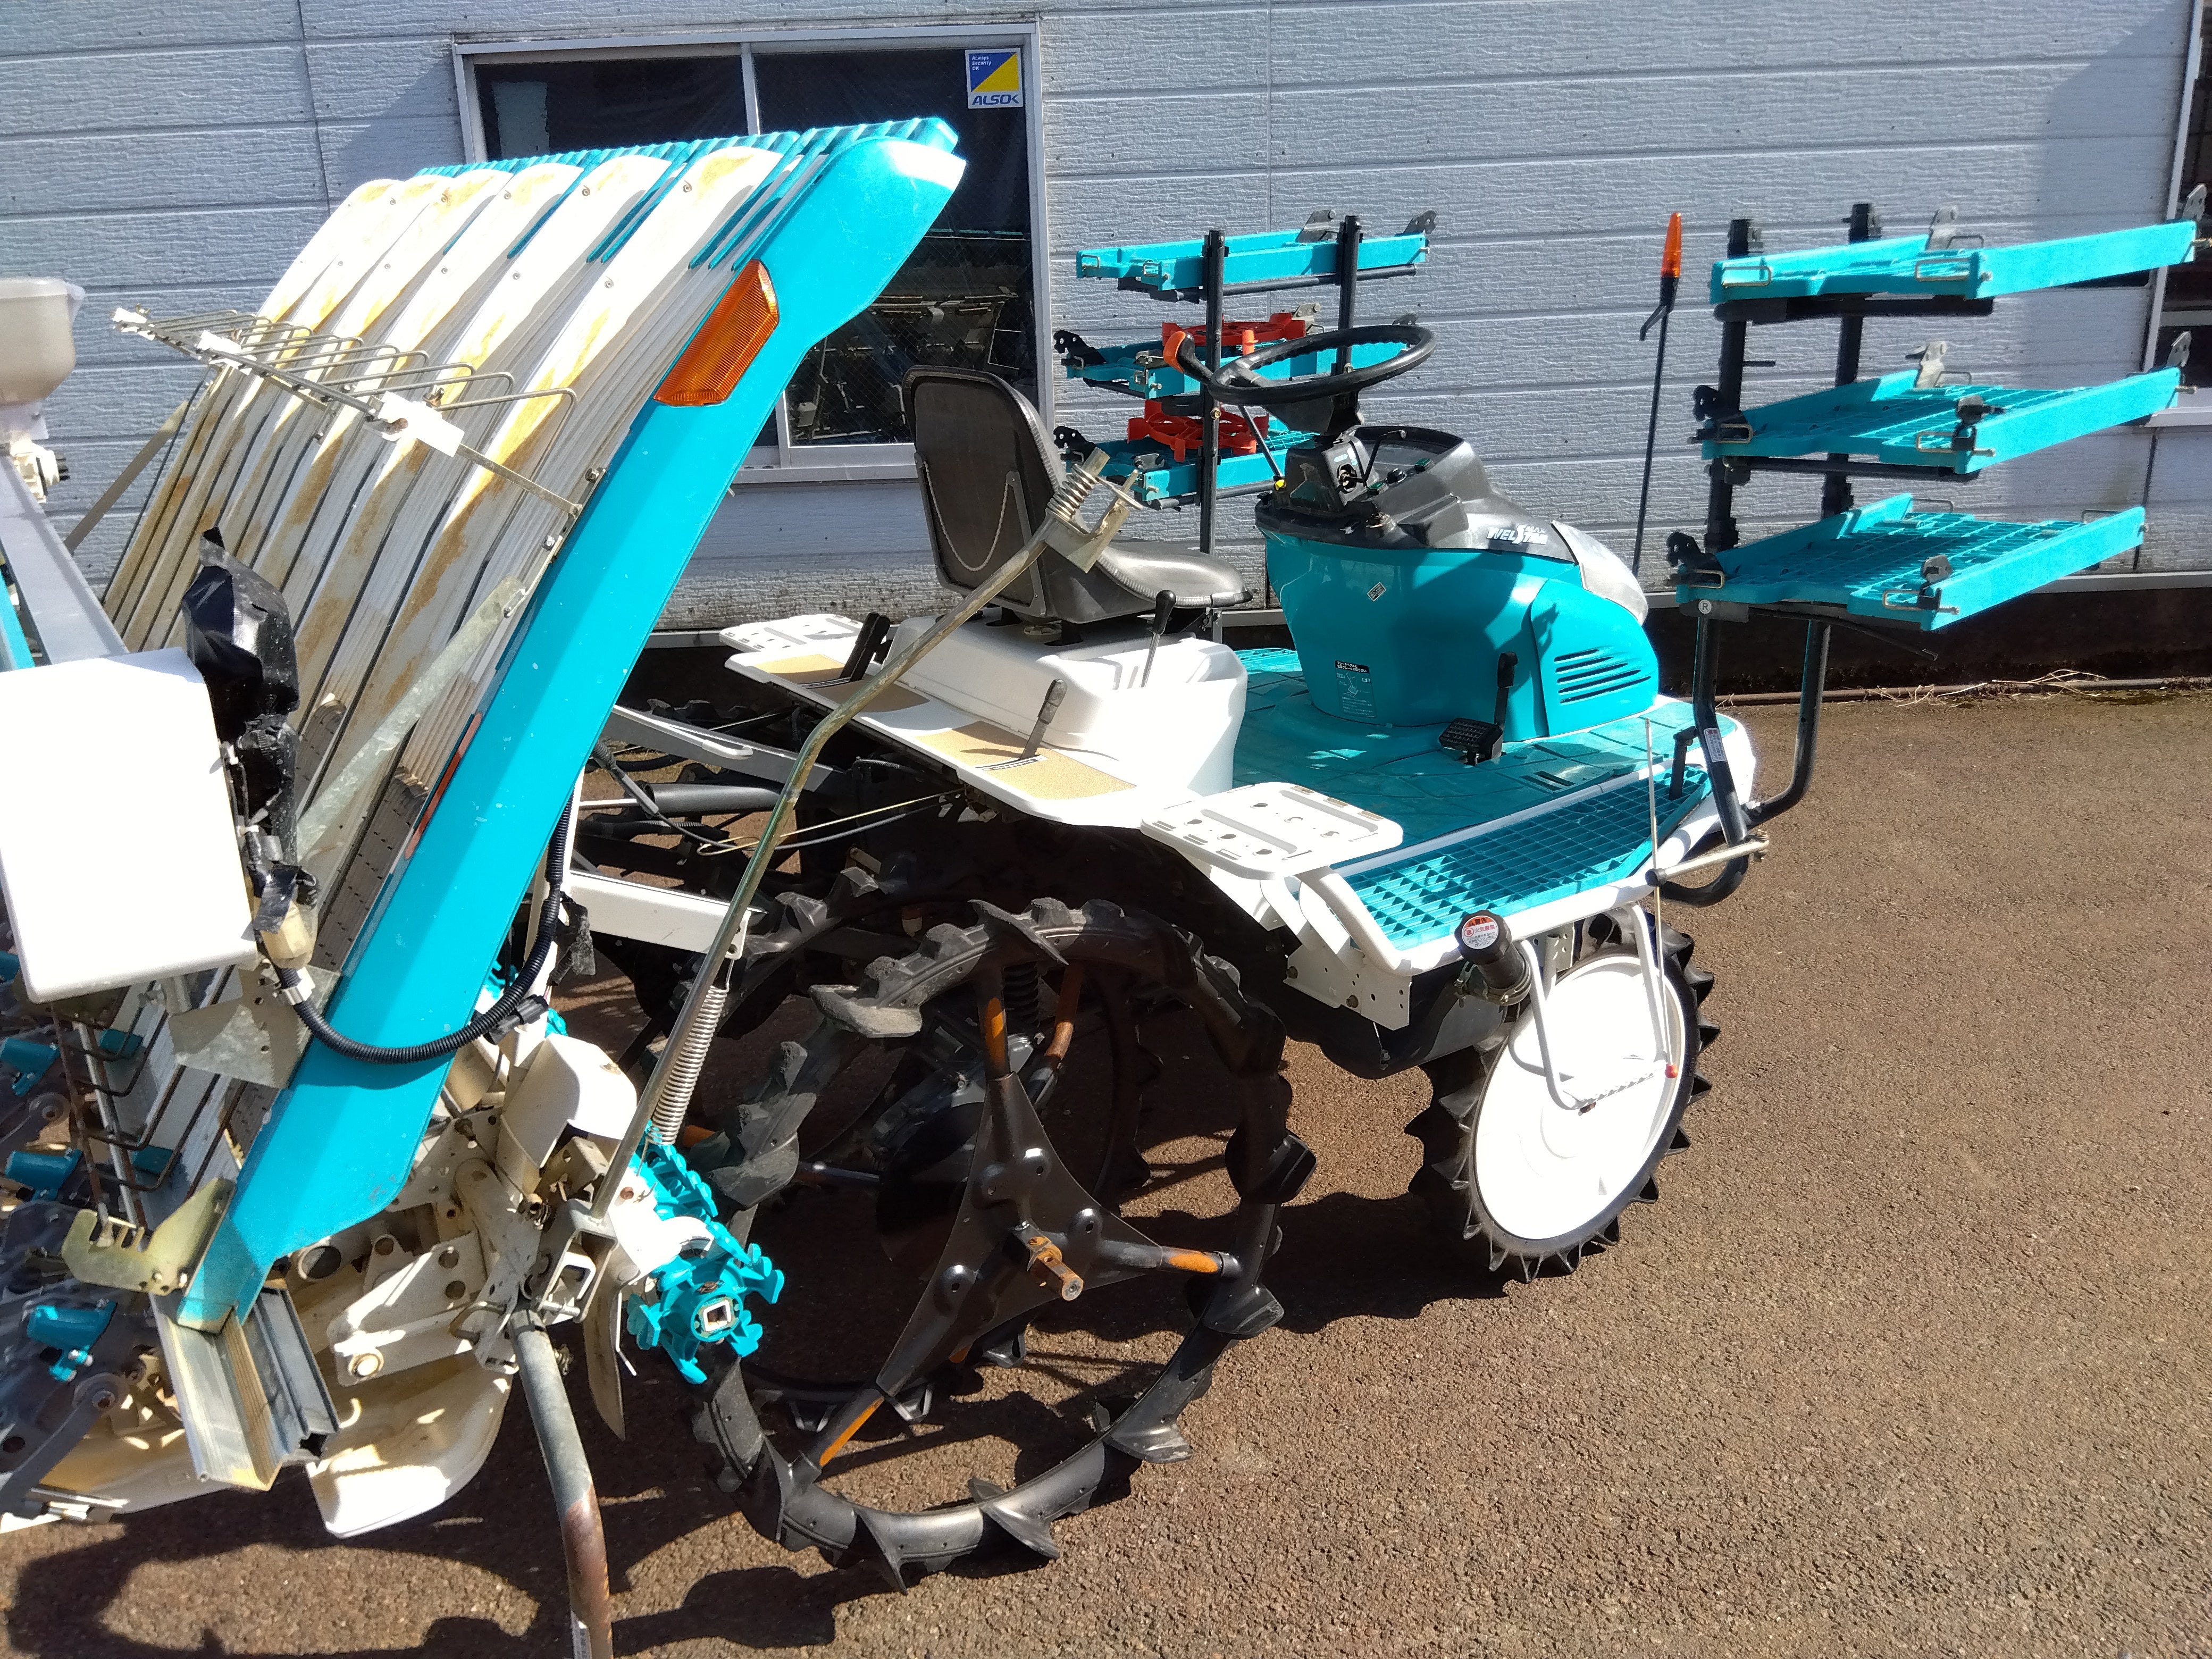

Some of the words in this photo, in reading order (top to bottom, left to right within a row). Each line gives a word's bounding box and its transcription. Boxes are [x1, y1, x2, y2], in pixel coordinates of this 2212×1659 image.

[971, 94, 1020, 105] ALSOK
[1474, 924, 1495, 933] 火気厳禁
